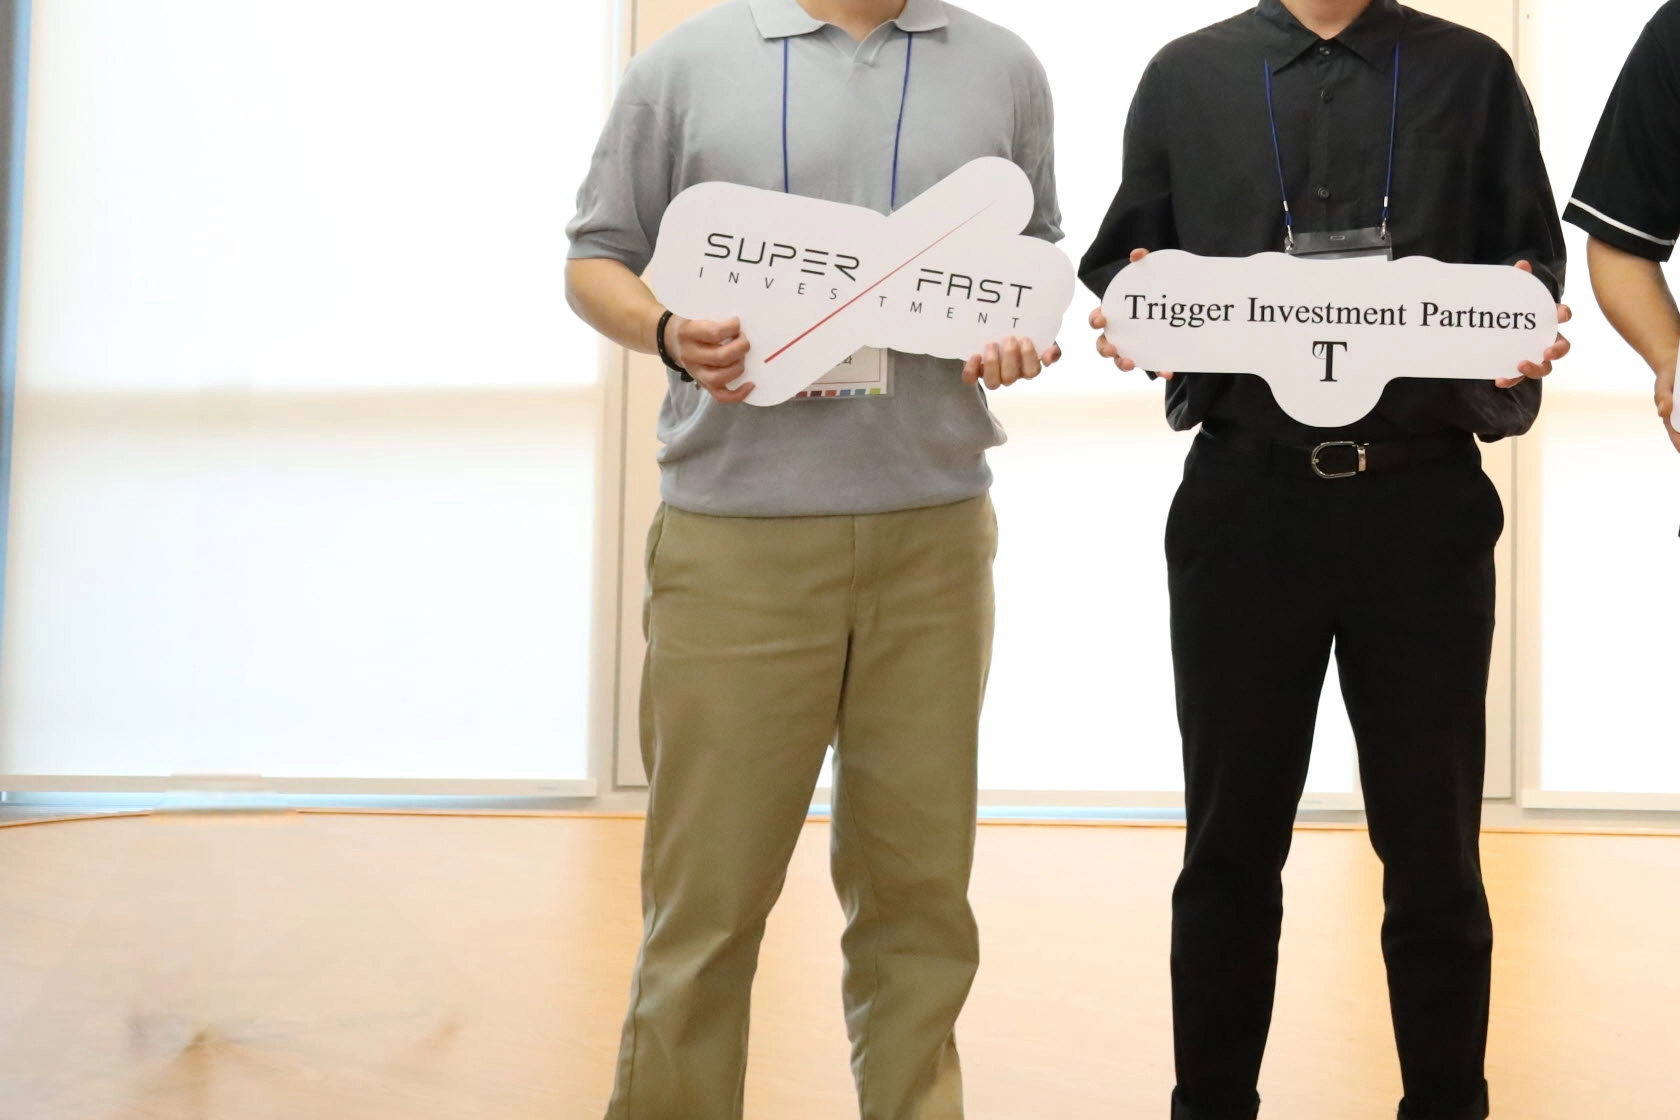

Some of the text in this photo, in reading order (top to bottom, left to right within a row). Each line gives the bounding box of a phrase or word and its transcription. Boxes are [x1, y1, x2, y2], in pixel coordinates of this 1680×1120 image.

[698, 266, 1021, 329] INVESTMENT
[703, 232, 1033, 308] SUPER FAST
[1124, 293, 1537, 330] Trigger Investment Partners
